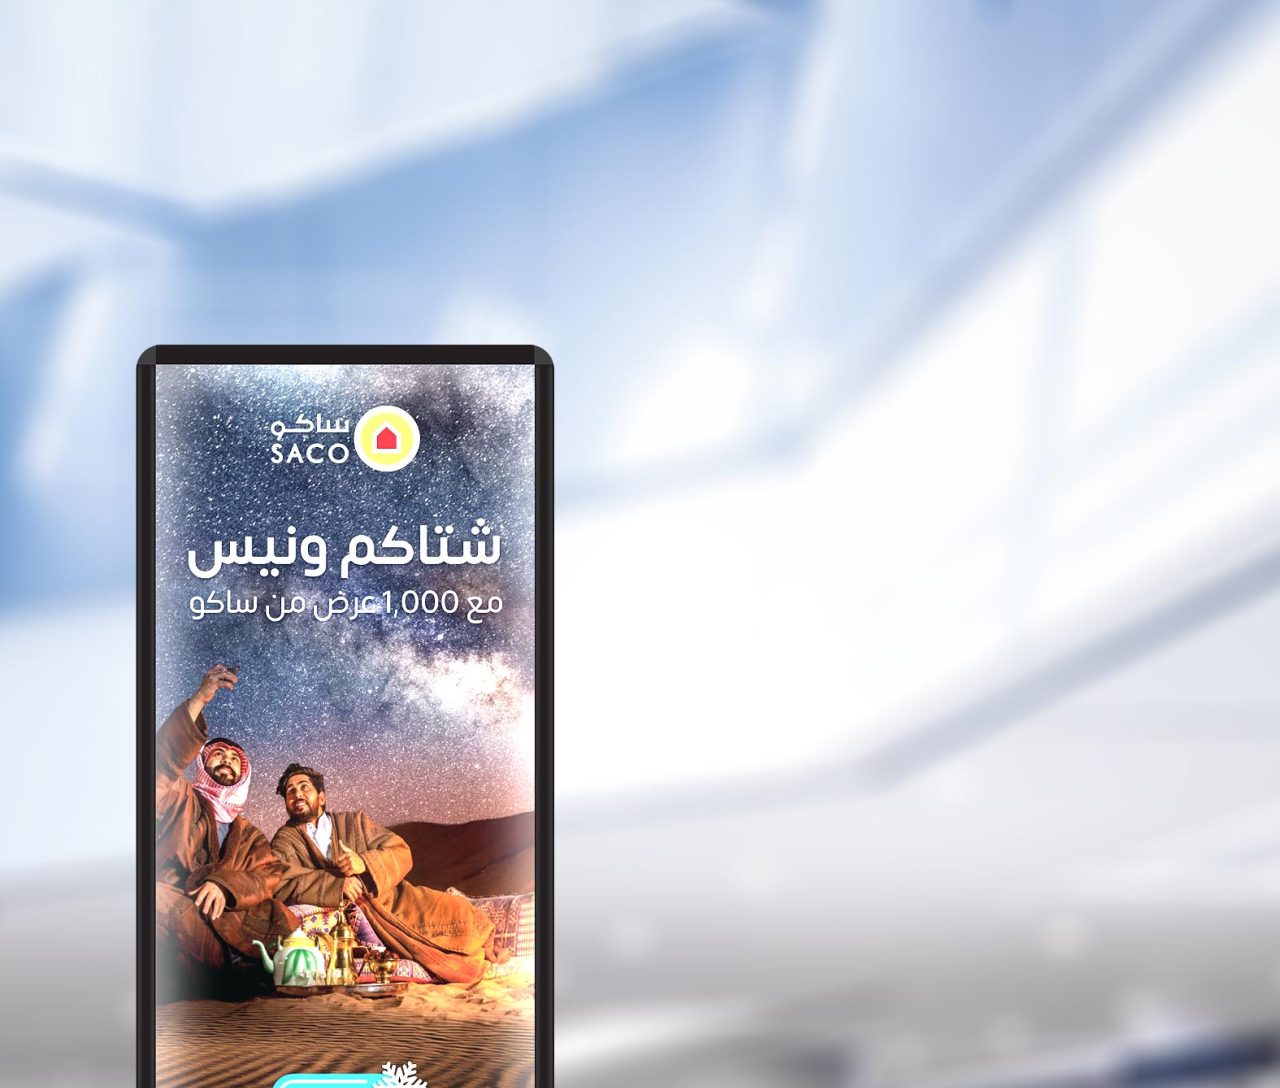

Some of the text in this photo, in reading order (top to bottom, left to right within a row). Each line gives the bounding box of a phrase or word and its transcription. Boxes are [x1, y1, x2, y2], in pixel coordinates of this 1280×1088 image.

[270, 413, 350, 441] ساكو
[270, 443, 350, 464] SACO
[187, 518, 502, 580] شتاكم ونيس
[189, 589, 504, 624] مع 1,000 عرض من ساكو
